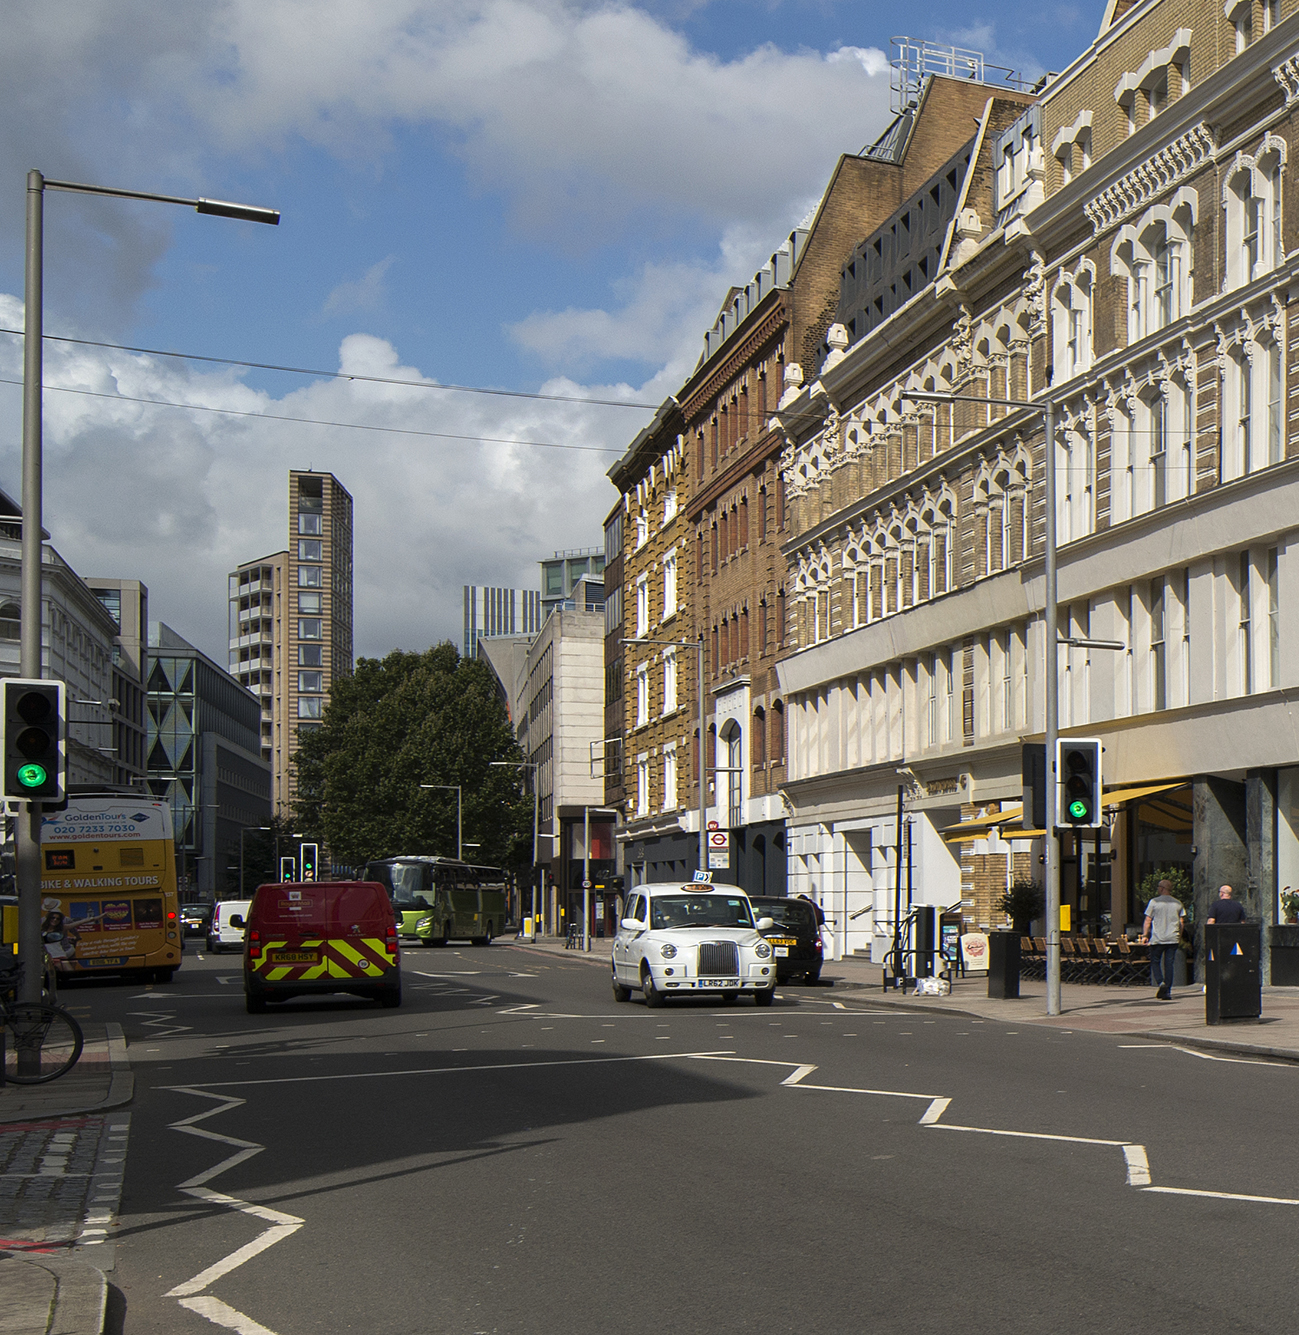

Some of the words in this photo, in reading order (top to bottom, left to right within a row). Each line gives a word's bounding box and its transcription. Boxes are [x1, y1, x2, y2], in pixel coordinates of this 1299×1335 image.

[108, 824, 135, 832] 7030
[49, 832, 140, 840] www.goldentours.com
[596, 870, 609, 879] 42
[64, 880, 71, 888] &
[74, 877, 122, 888] WALKING
[124, 876, 158, 886] TOURS
